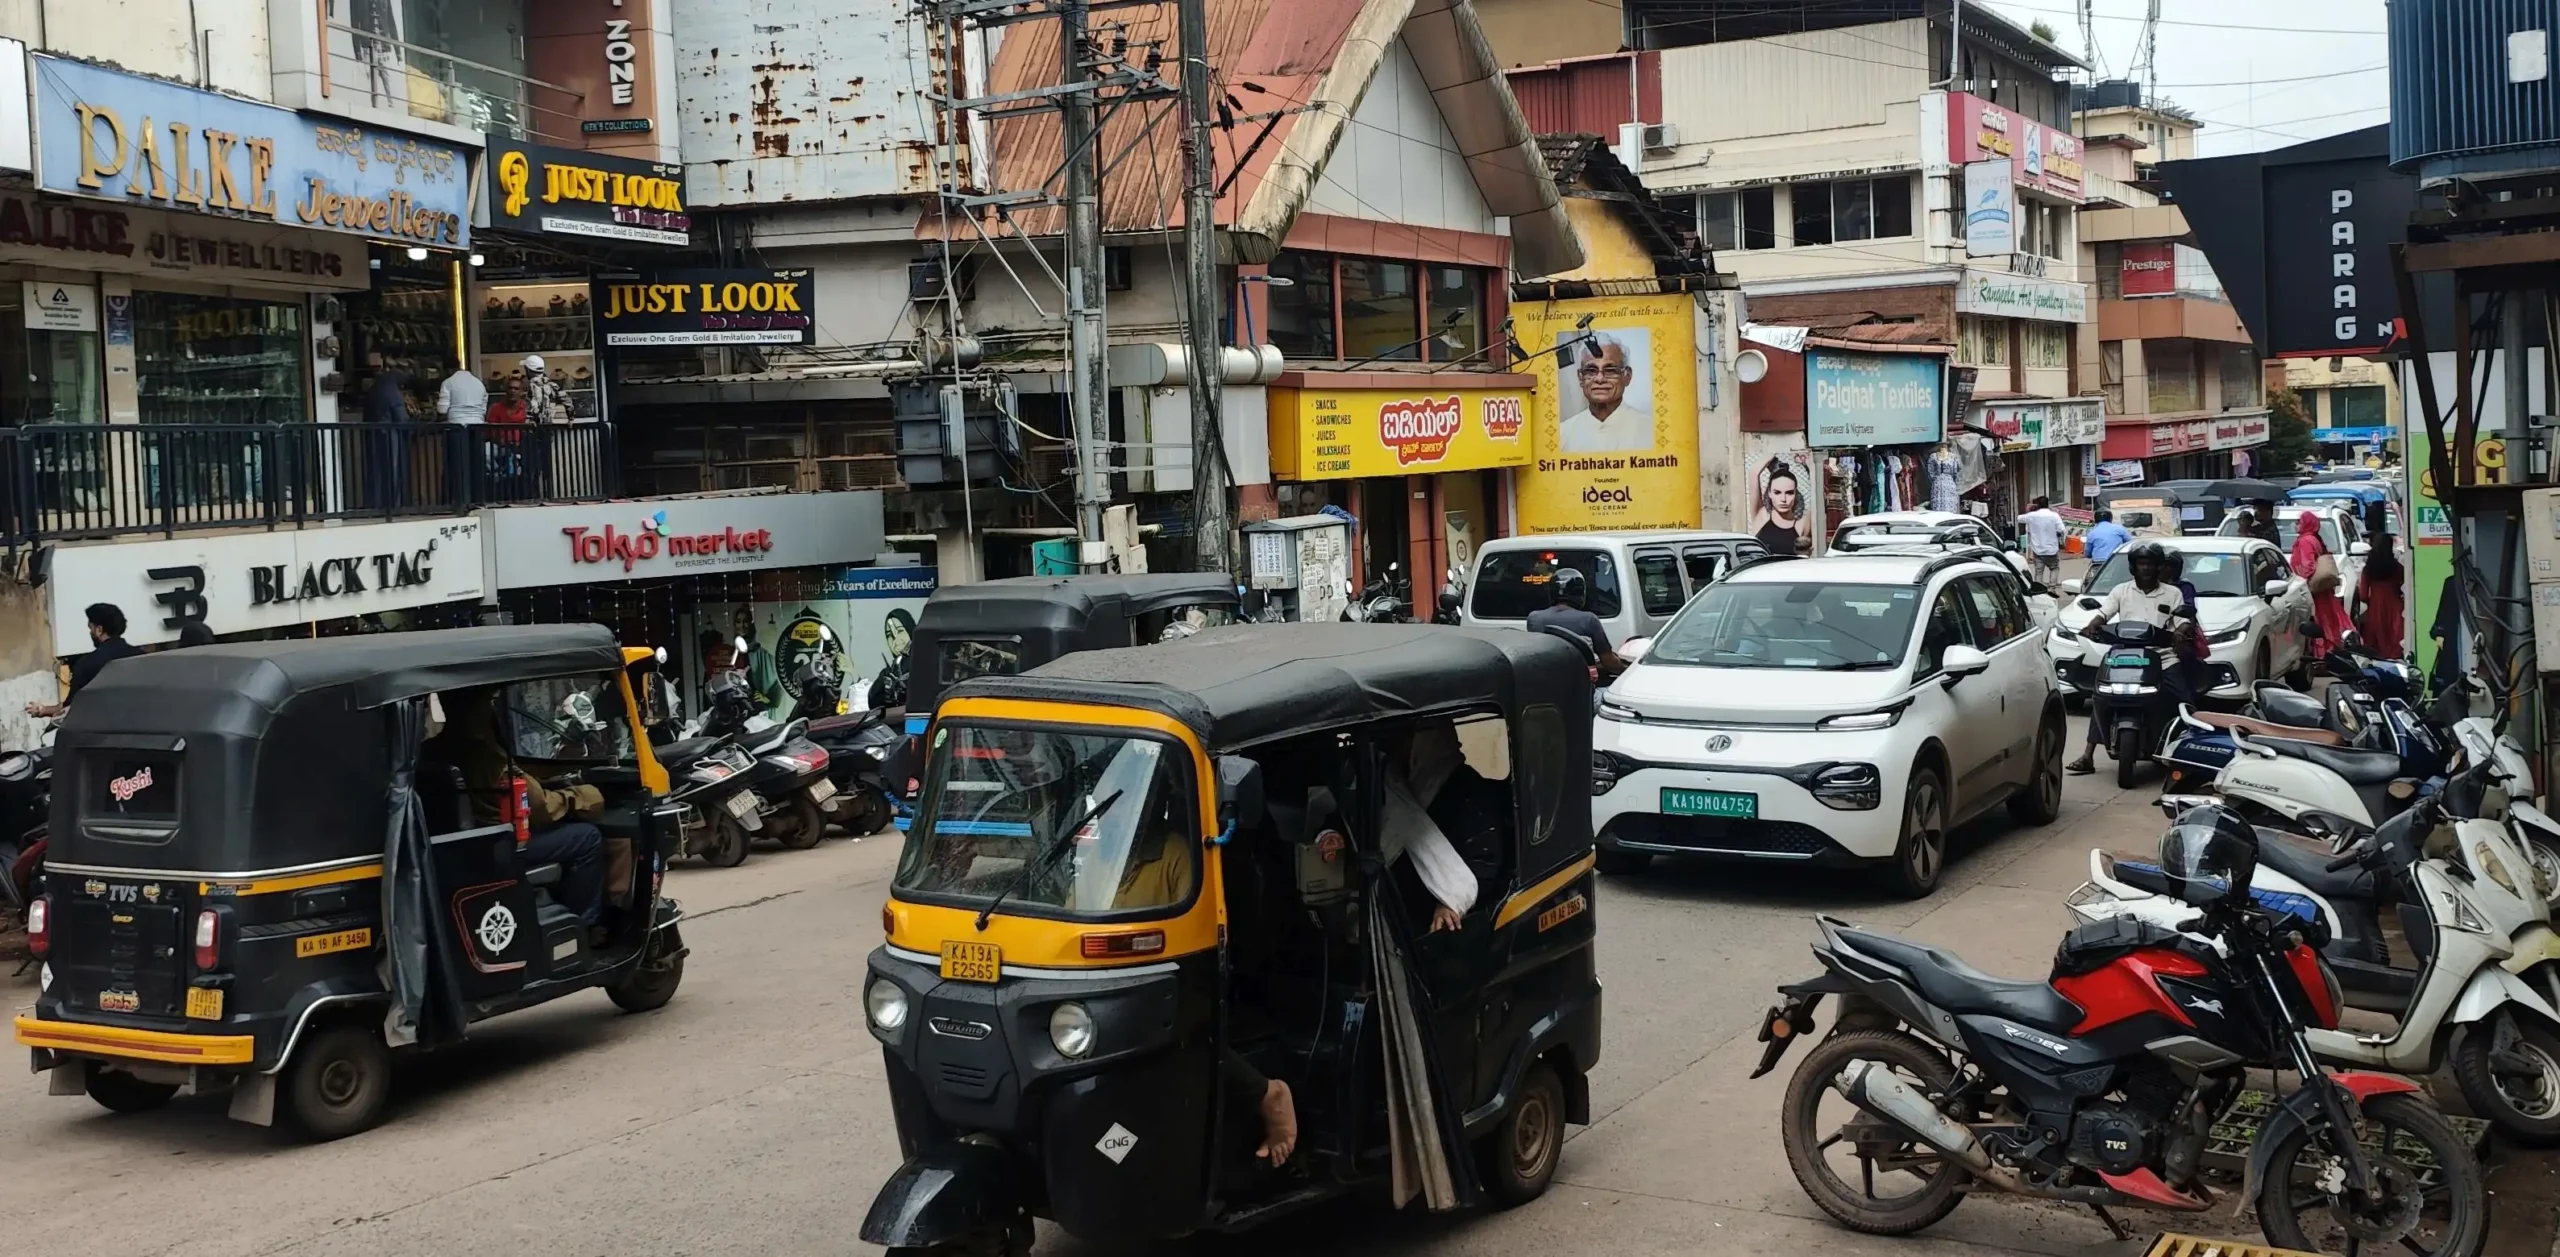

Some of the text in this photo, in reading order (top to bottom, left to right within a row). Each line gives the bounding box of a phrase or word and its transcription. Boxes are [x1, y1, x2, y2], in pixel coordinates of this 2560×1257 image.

[605, 20, 635, 104] ZONE
[605, 120, 648, 131] COLLECTIONS
[74, 101, 461, 244] PALKE Jewellers
[541, 163, 683, 212] JUST LOOK
[550, 219, 579, 231] Exclusive
[580, 223, 593, 233] One
[594, 225, 612, 235] Gram
[612, 226, 628, 237] Gold
[633, 230, 660, 240] Imitation
[660, 232, 687, 244] Jewellery
[149, 233, 342, 278] JEWELLERS
[2331, 189, 2357, 340] PARAG
[2123, 259, 2171, 272] Prestige
[604, 282, 801, 319] JUST LOOK
[1526, 312, 1541, 321] We
[1544, 311, 1573, 321] believe
[1610, 306, 1627, 317] still
[1630, 306, 1650, 316] with
[611, 332, 795, 343] Exclusive One Gram Gold & Imitation Jewellery
[1316, 399, 1337, 410] SNACKS
[1817, 379, 1875, 414] Palghat
[1878, 381, 1932, 409] Textiles
[1316, 414, 1351, 425] SANDWICHES
[1484, 400, 1521, 423] IDEAL
[1383, 405, 1459, 439] ಐಡಿಯಲ್
[1316, 430, 1336, 441] JUICES
[1317, 445, 1351, 456] MILKSHAKES
[1317, 460, 1350, 472] ICE CREAMS
[1538, 459, 1555, 472] Sri
[1560, 457, 1626, 471] Prabhakar
[1630, 454, 1678, 469] Kamath
[1583, 486, 1633, 503] ideal
[1530, 525, 1544, 533] You
[1559, 523, 1572, 532] the
[1572, 523, 1588, 531] best
[1589, 523, 1607, 531] Boss
[1620, 521, 1641, 531] could
[1659, 520, 1677, 529] wish
[2429, 523, 2453, 533] Burk
[562, 524, 774, 573] Tokyo market
[675, 554, 765, 568] EXPERIENCE THE LIFESTYLE
[250, 548, 434, 606] BLACK TAG
[838, 581, 863, 592] Years
[866, 579, 878, 591] of
[879, 577, 935, 591] Excellence!
[1708, 736, 1731, 751] MG
[110, 767, 153, 801] Kushi
[1672, 792, 1753, 813] KA19MQ4752
[109, 884, 138, 902] TVS
[303, 931, 367, 953] KA 19 AF 3450
[952, 944, 993, 963] KA19A
[952, 962, 993, 980] E2565
[2000, 1023, 2069, 1057] RAIDER
[1104, 1136, 1129, 1149] CNG
[2105, 1140, 2127, 1151] TVS
